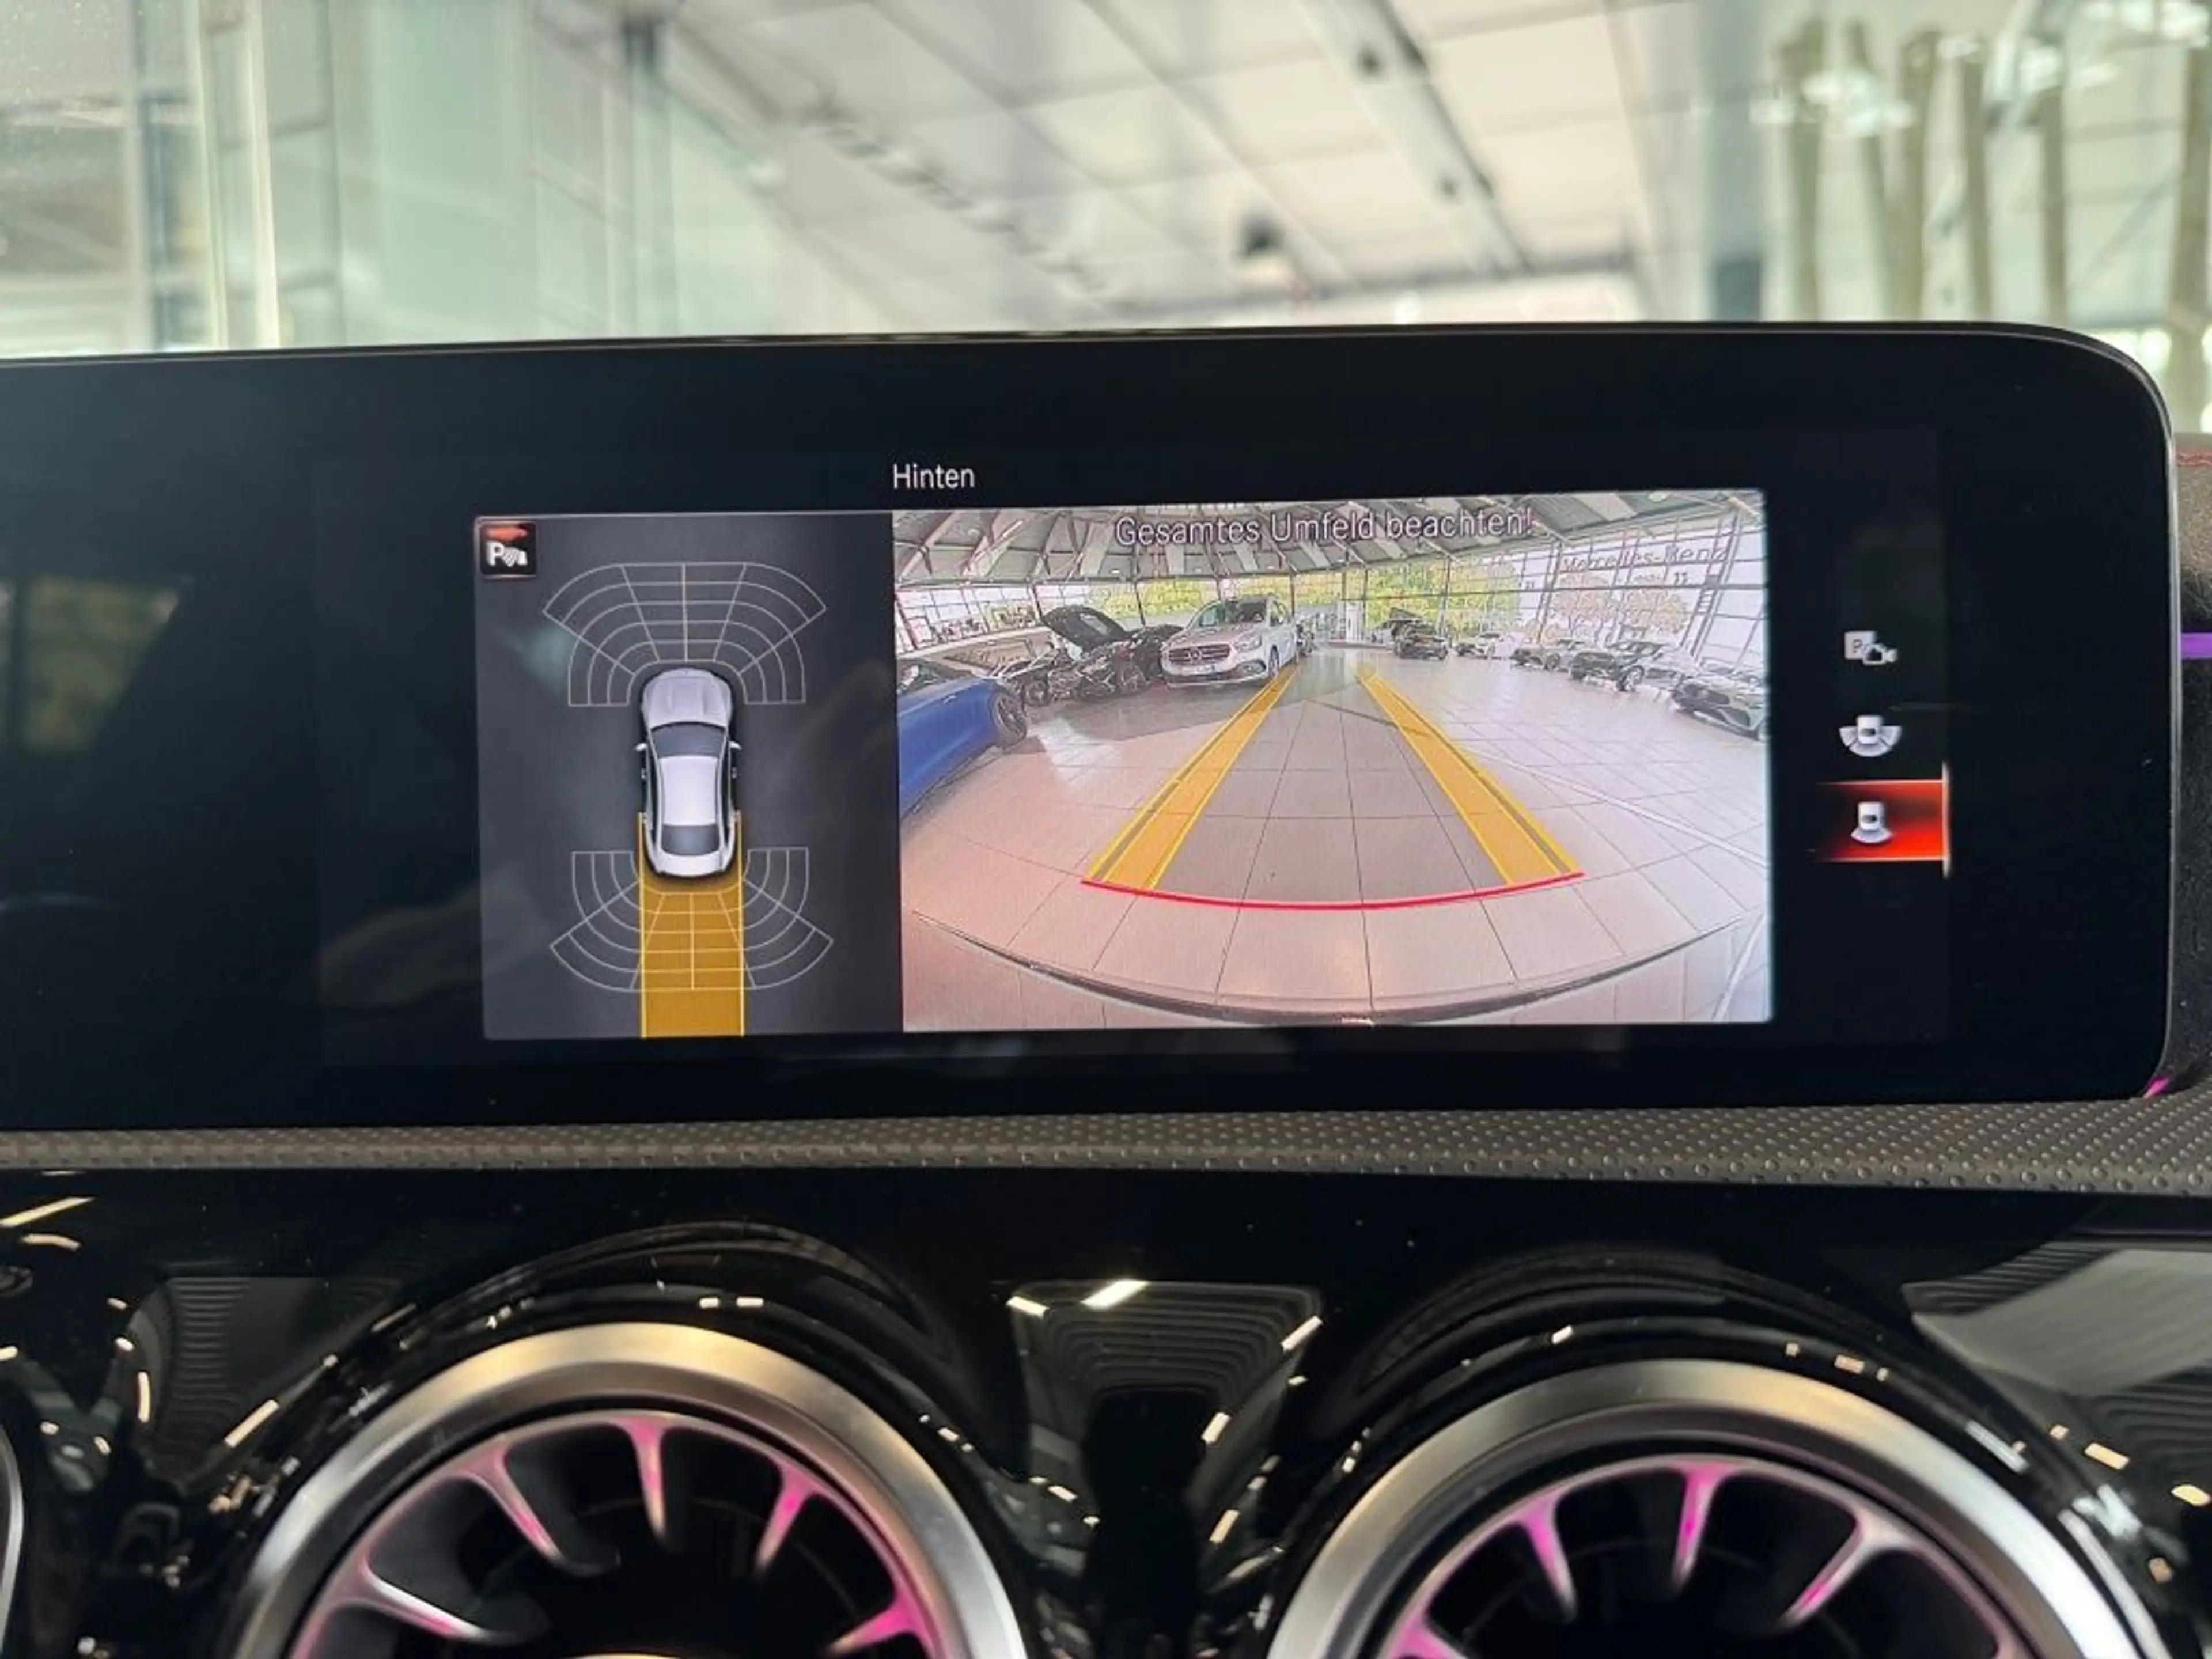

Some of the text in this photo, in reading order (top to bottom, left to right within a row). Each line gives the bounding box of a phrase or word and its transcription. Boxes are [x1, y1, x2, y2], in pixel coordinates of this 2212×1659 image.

[893, 463, 975, 489] Hinten
[1116, 506, 1532, 546] Gesamtes Umfeld beachten!
